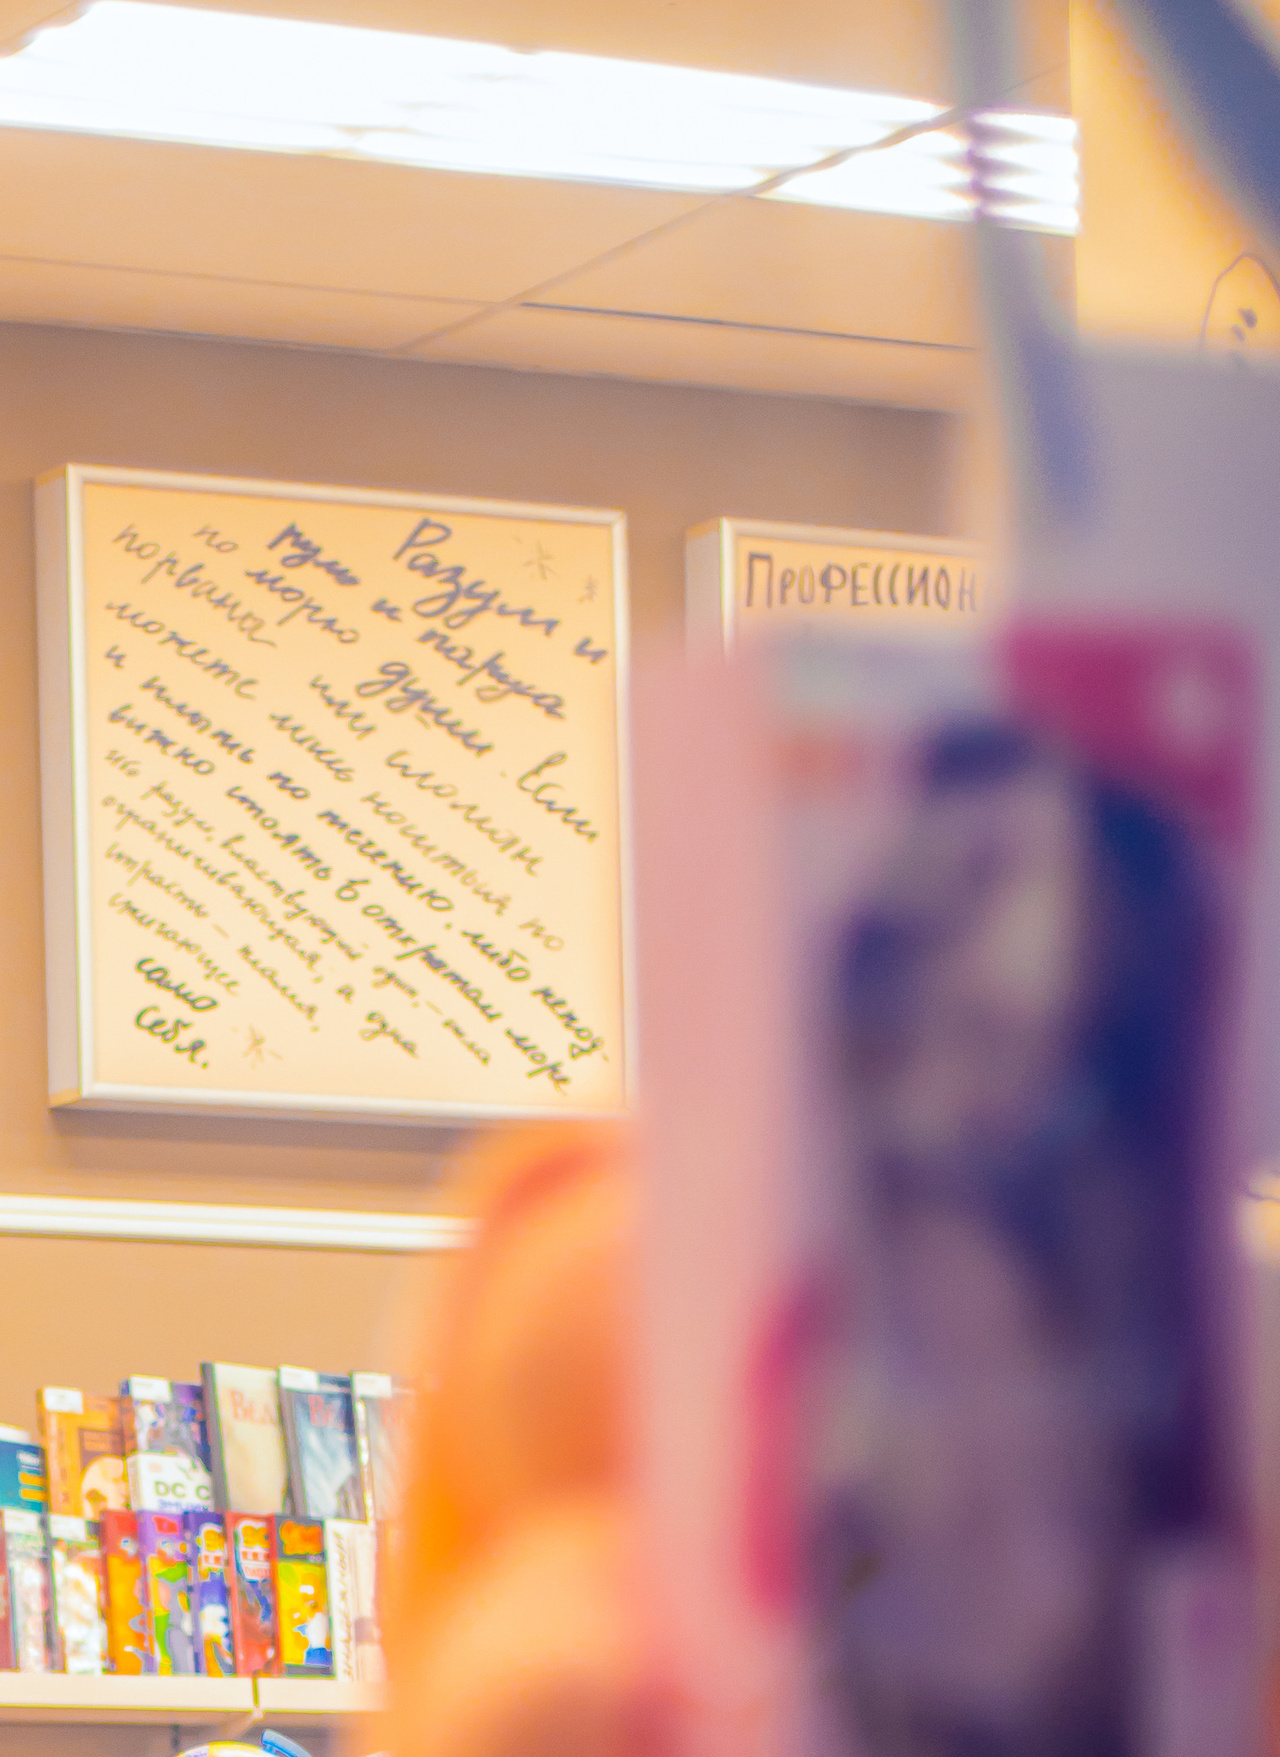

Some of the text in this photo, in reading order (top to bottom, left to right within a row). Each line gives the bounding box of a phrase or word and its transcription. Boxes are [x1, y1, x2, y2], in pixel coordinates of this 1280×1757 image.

[370, 596, 403, 623] и
[392, 517, 609, 666] Разум и
[104, 643, 127, 670] и
[265, 769, 311, 802] по
[192, 523, 240, 554] по
[244, 567, 361, 644] морю
[516, 751, 600, 844] Если
[309, 673, 378, 740] или
[104, 600, 260, 700] можете
[518, 917, 565, 953] по
[107, 702, 217, 776] вижно
[224, 785, 333, 882] стоять
[503, 1025, 573, 1097] море
[133, 955, 219, 1014] само
